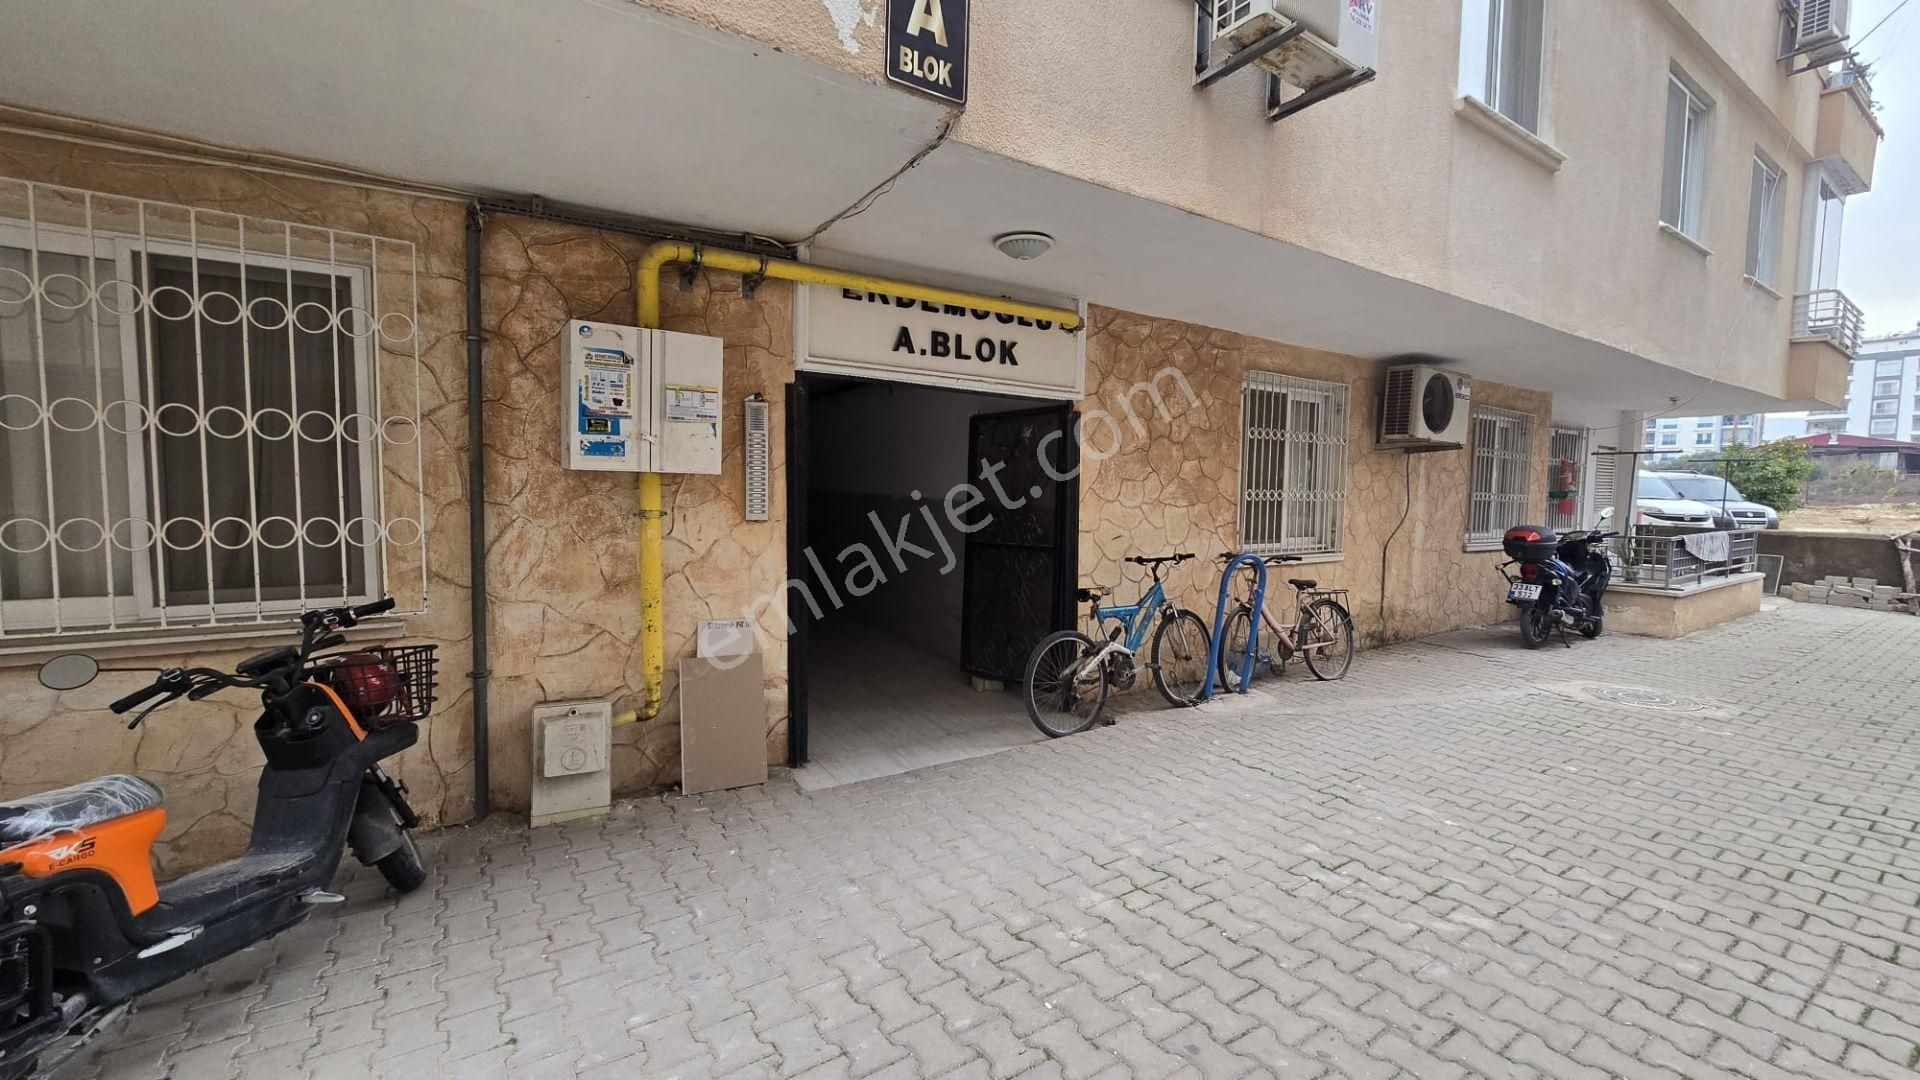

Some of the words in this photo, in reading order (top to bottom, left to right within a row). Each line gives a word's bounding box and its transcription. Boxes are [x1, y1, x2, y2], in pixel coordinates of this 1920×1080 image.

[906, 0, 949, 48] A
[899, 45, 953, 89] BLOK
[892, 326, 1019, 366] A.BLOK
[48, 849, 96, 870] E-CARGO
